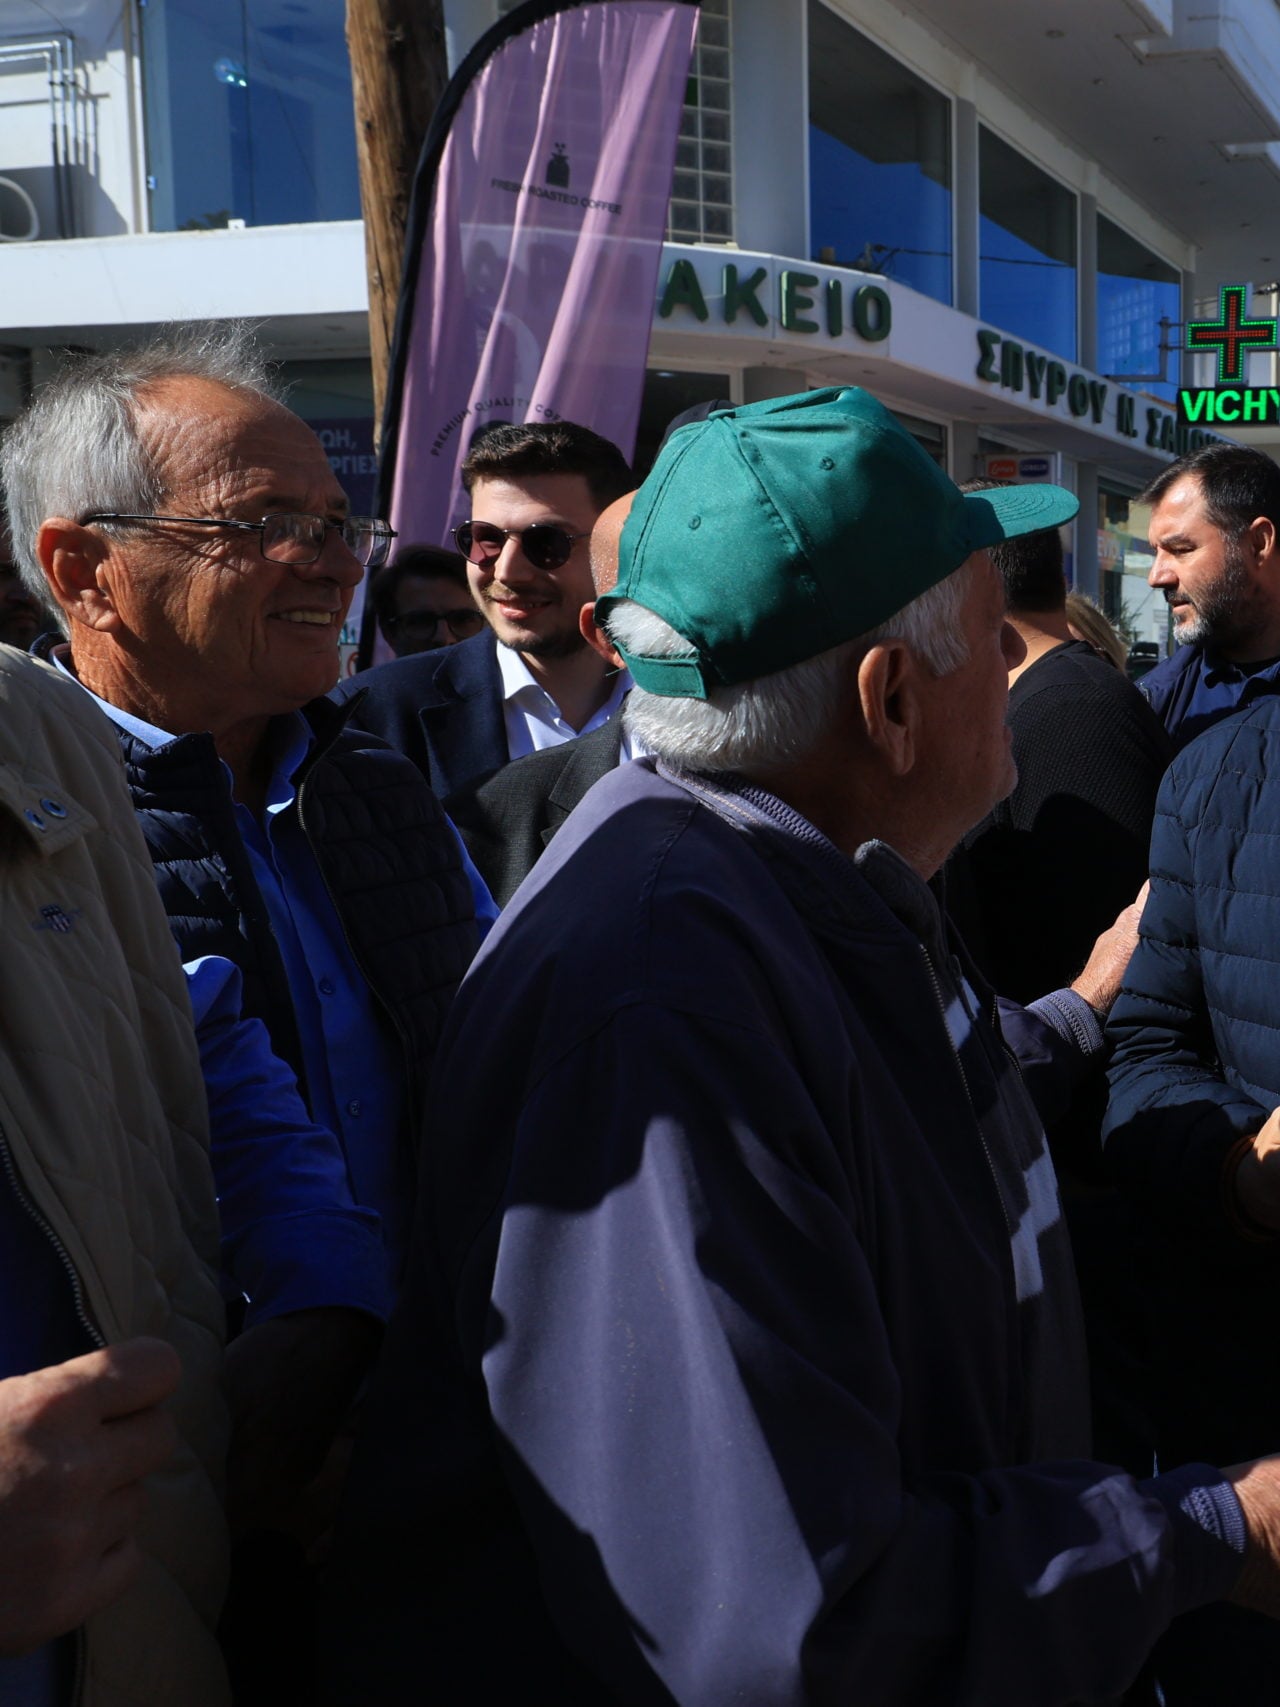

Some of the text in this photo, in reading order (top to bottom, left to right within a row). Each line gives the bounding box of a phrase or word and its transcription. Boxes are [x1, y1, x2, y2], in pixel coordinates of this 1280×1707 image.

[528, 185, 579, 206] ROASTED
[580, 197, 623, 215] COFFEE
[659, 259, 892, 342] ΑΚΕΙΟ
[976, 330, 1107, 424] ΣΠΥΡΟΥ
